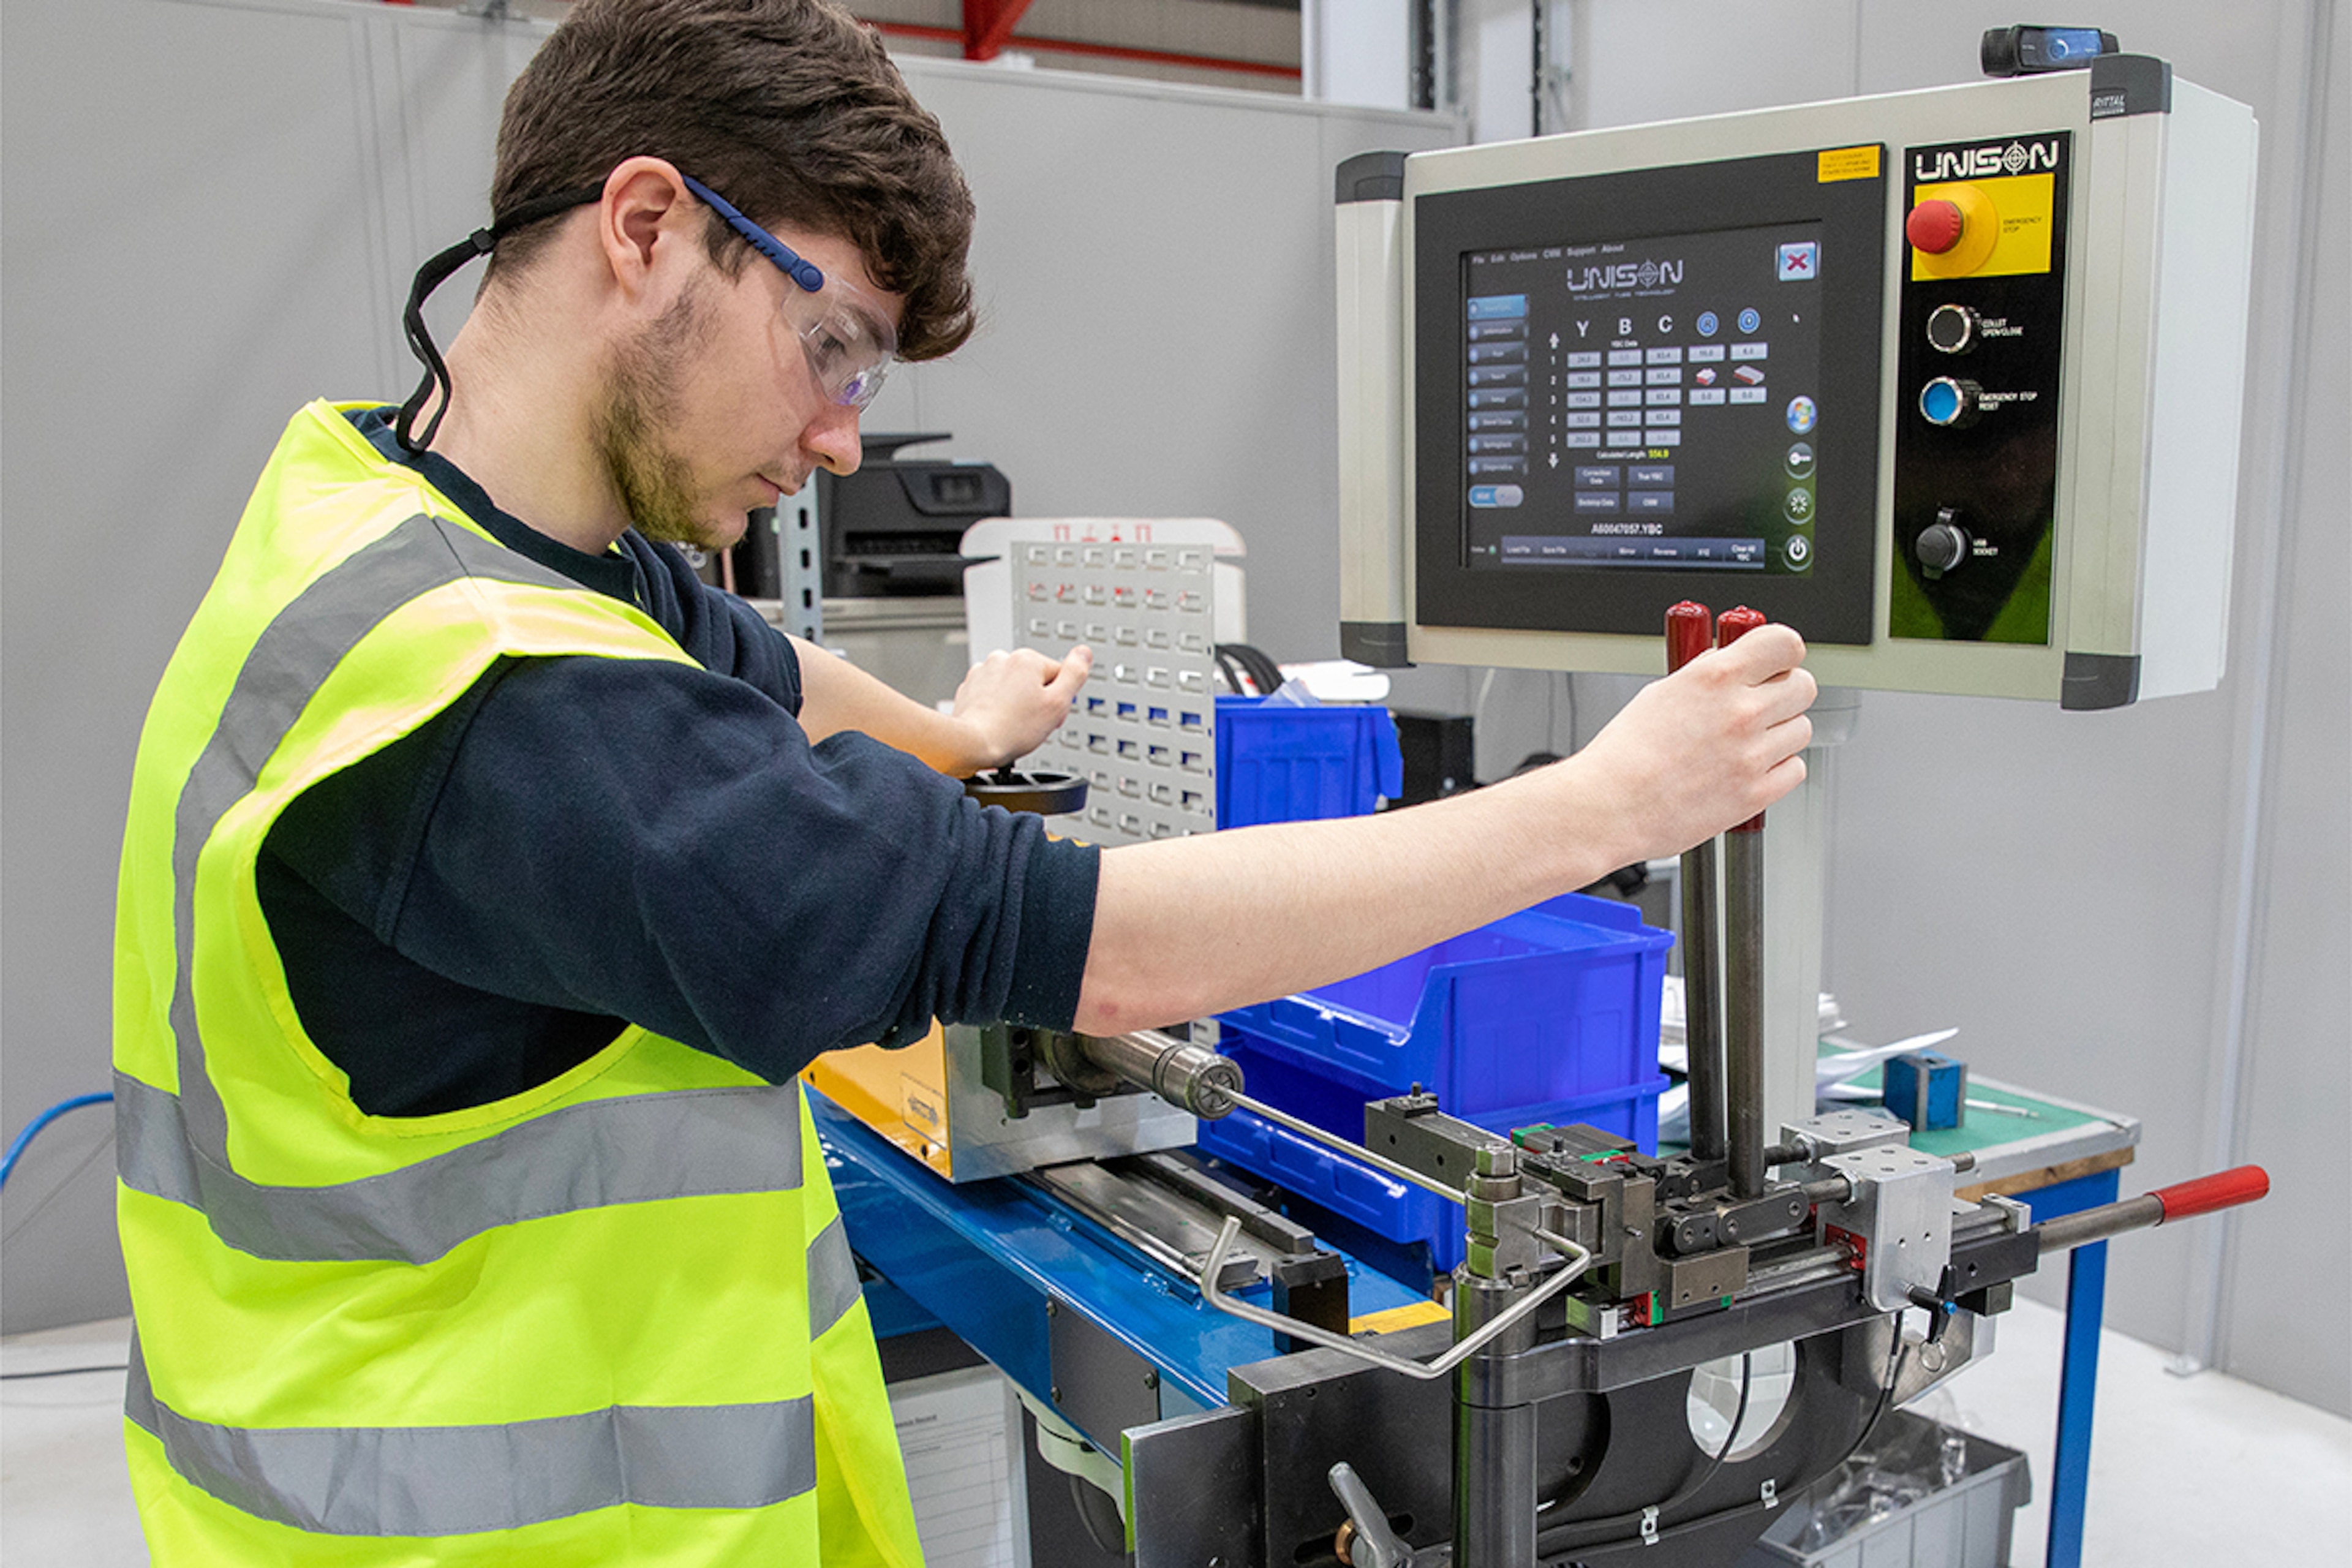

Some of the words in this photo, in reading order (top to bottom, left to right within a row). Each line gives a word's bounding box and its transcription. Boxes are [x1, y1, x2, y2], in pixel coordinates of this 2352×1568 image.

[1916, 140, 2059, 181] UNISON
[2003, 216, 2042, 227] EMERGENCY
[1567, 246, 1596, 257] Support
[1601, 244, 1624, 254] About
[1567, 258, 1683, 291] UNISON
[1577, 320, 1589, 337] Y
[1619, 318, 1632, 335] B
[1658, 314, 1673, 333] C
[1551, 355, 1556, 365] 1
[1550, 375, 1556, 385] 2
[1550, 394, 1556, 404] 3
[2019, 391, 2038, 401] STOP
[1550, 415, 1556, 424] 4
